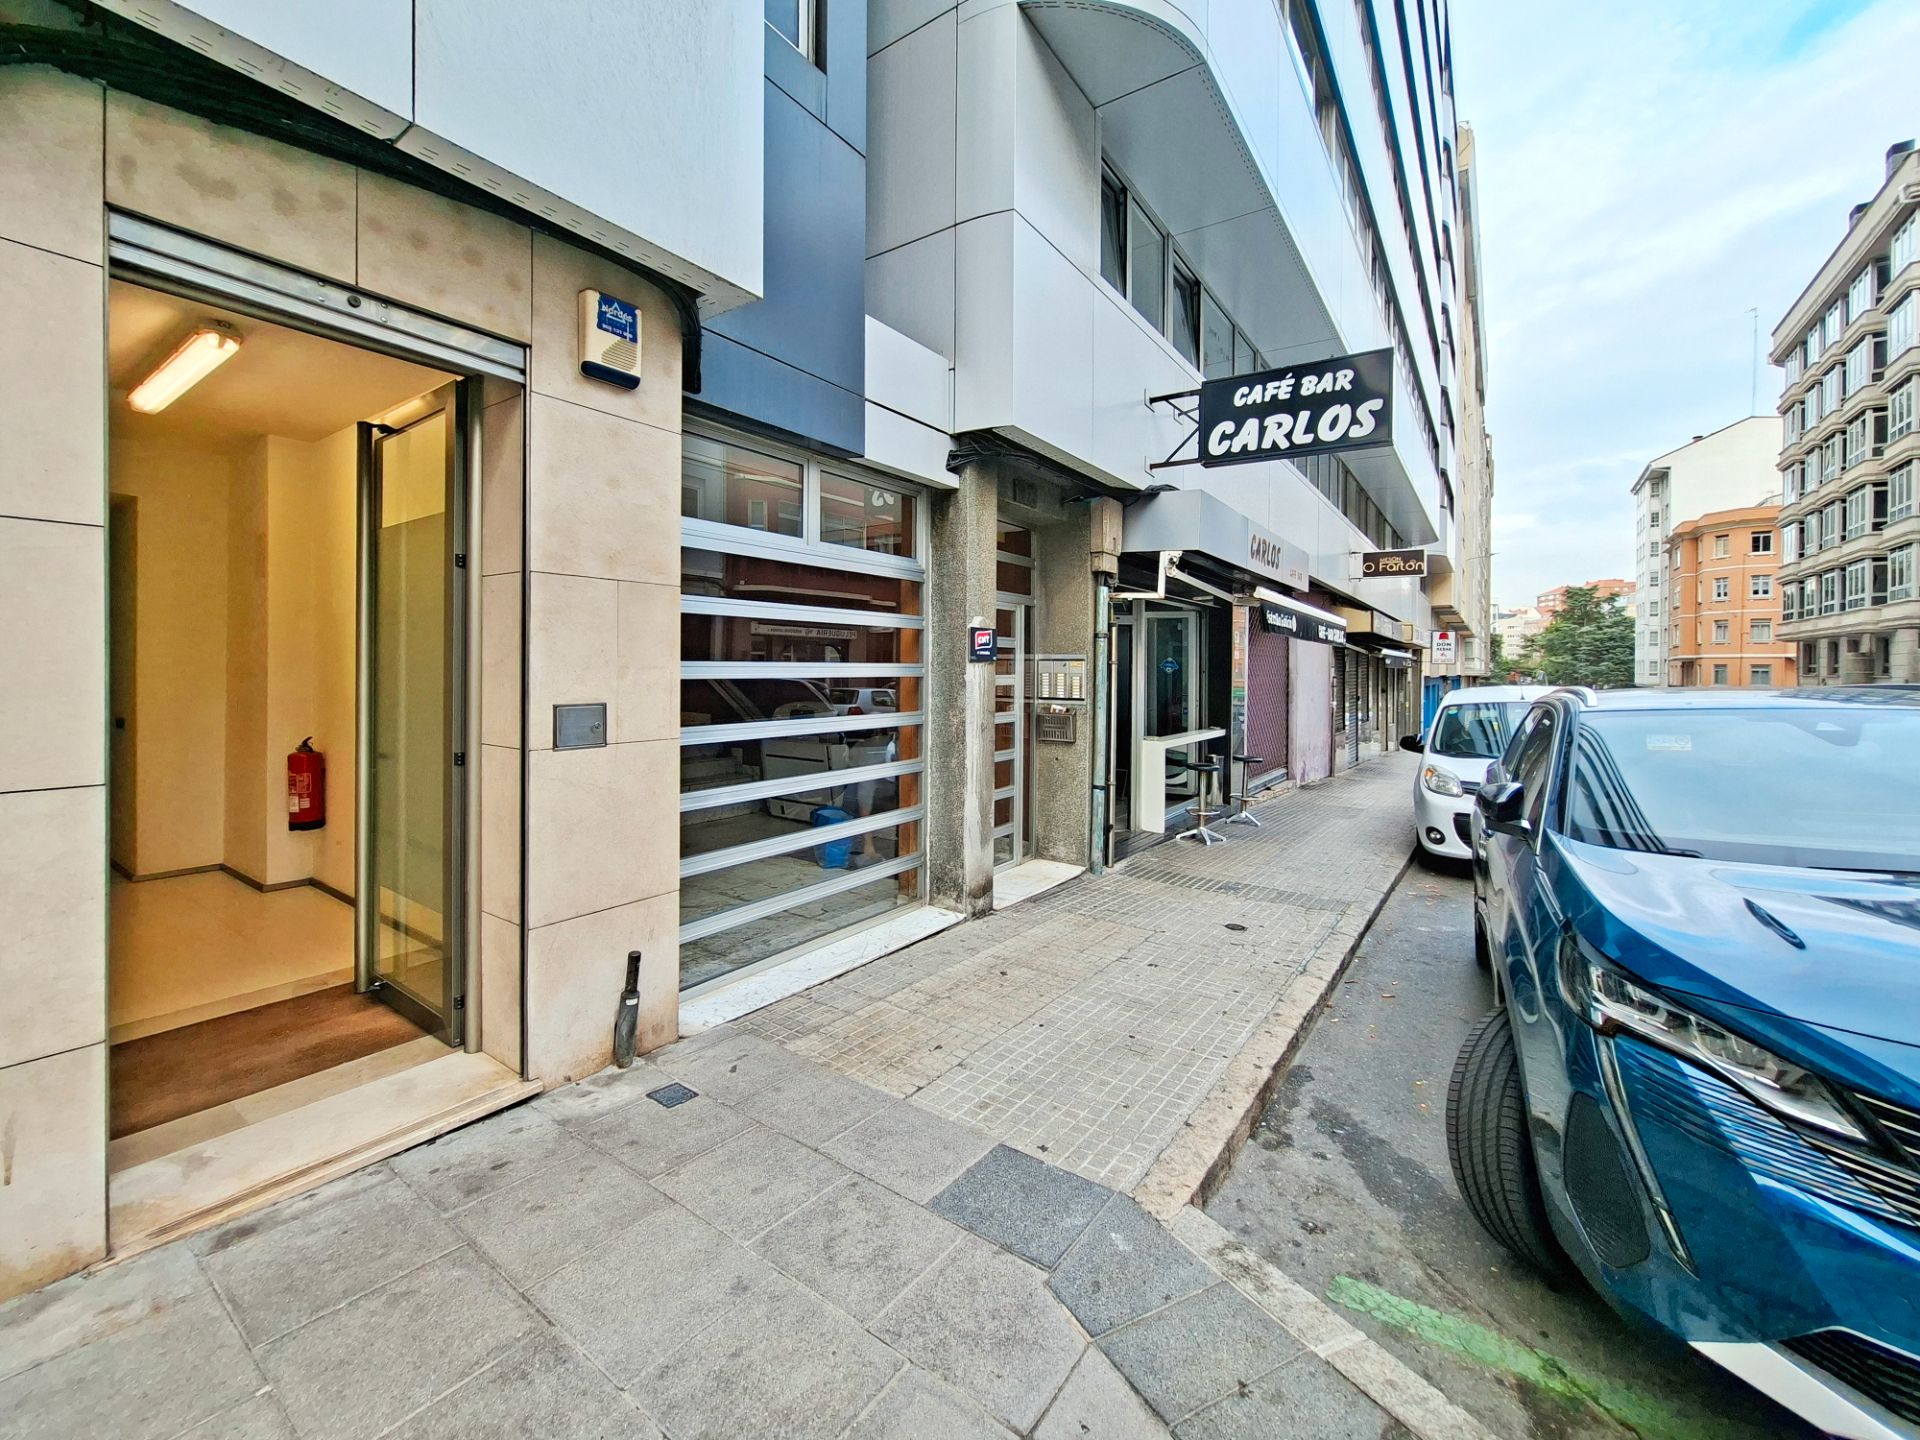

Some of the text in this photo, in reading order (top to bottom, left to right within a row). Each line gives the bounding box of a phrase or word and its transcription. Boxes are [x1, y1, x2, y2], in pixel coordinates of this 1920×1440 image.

[1233, 368, 1354, 408] CAFÉ BAR
[1207, 398, 1384, 456] CARLOS
[1250, 534, 1281, 570] CARLOS
[1363, 562, 1374, 572] O
